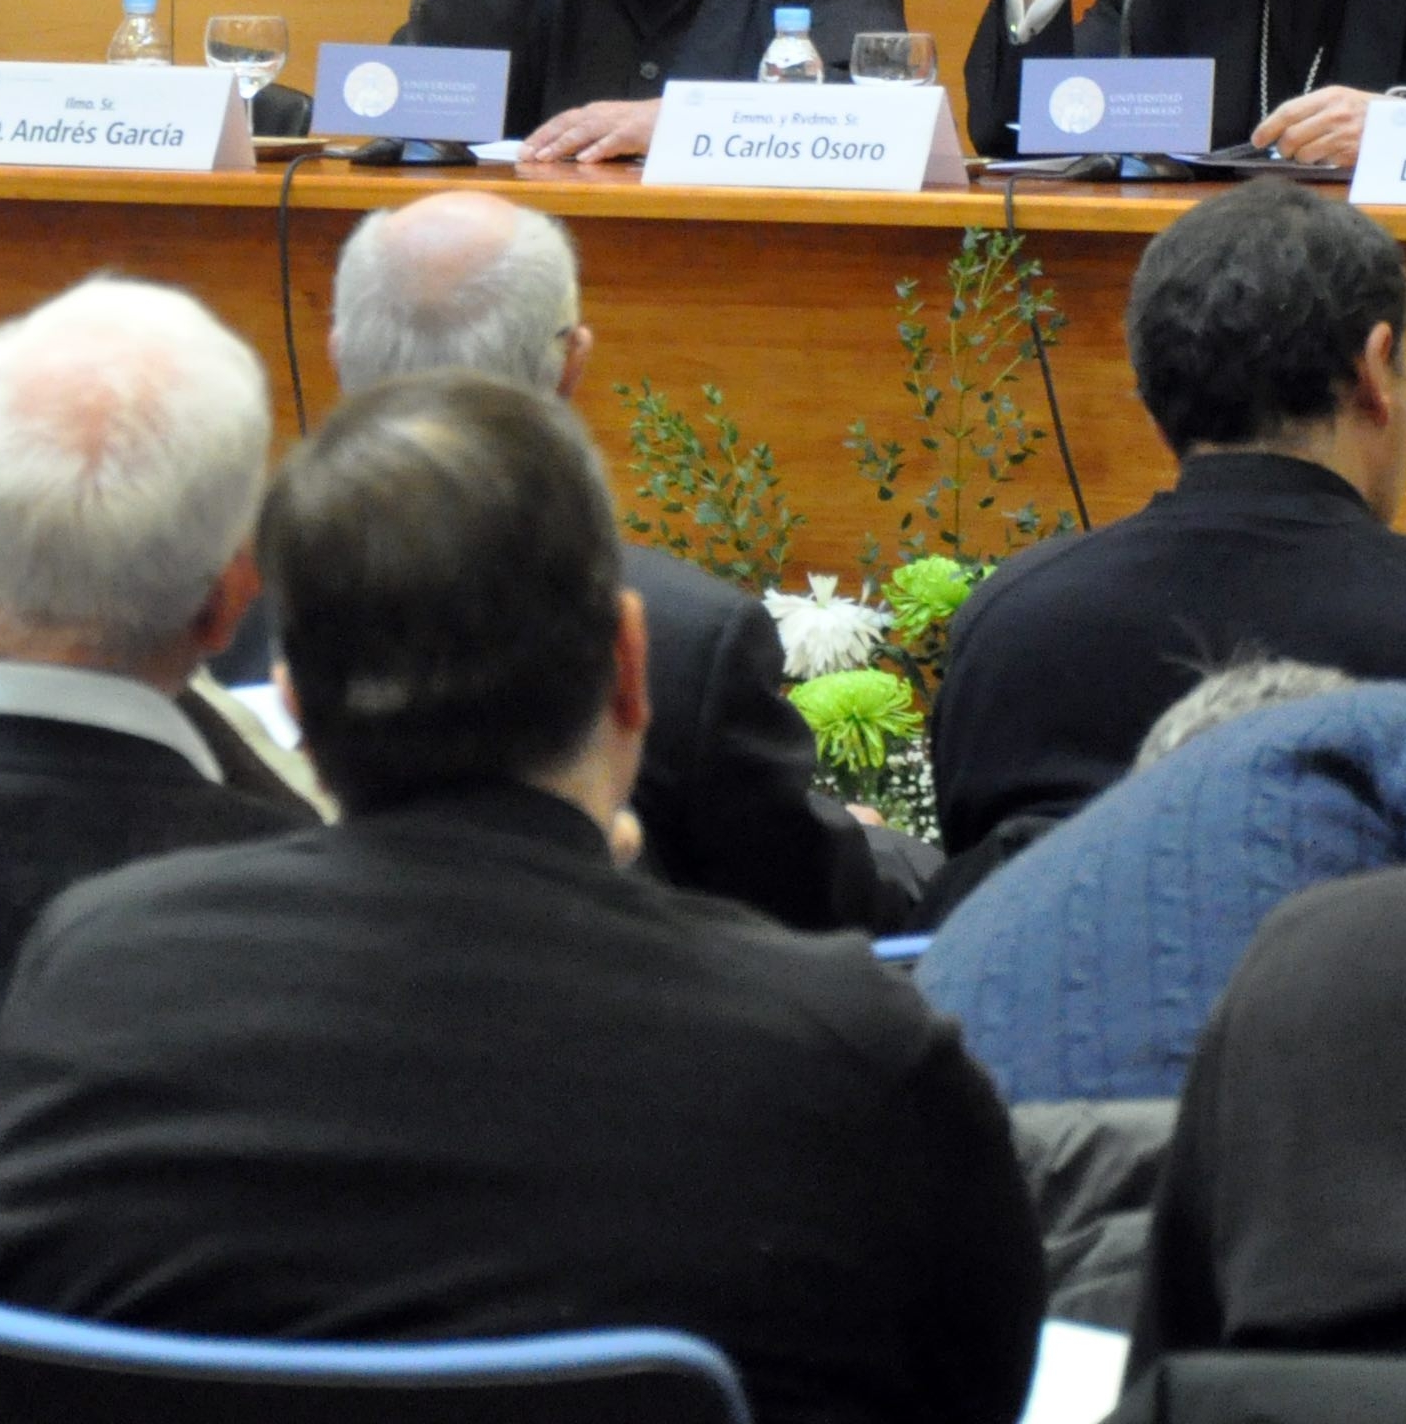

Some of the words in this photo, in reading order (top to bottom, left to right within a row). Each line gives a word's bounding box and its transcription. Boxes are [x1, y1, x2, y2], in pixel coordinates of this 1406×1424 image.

[10, 118, 98, 145] Andrés
[105, 121, 185, 147] García
[779, 115, 787, 127] y
[692, 133, 714, 158] D.
[724, 133, 802, 159] Carlos
[810, 135, 886, 161] Osoro
